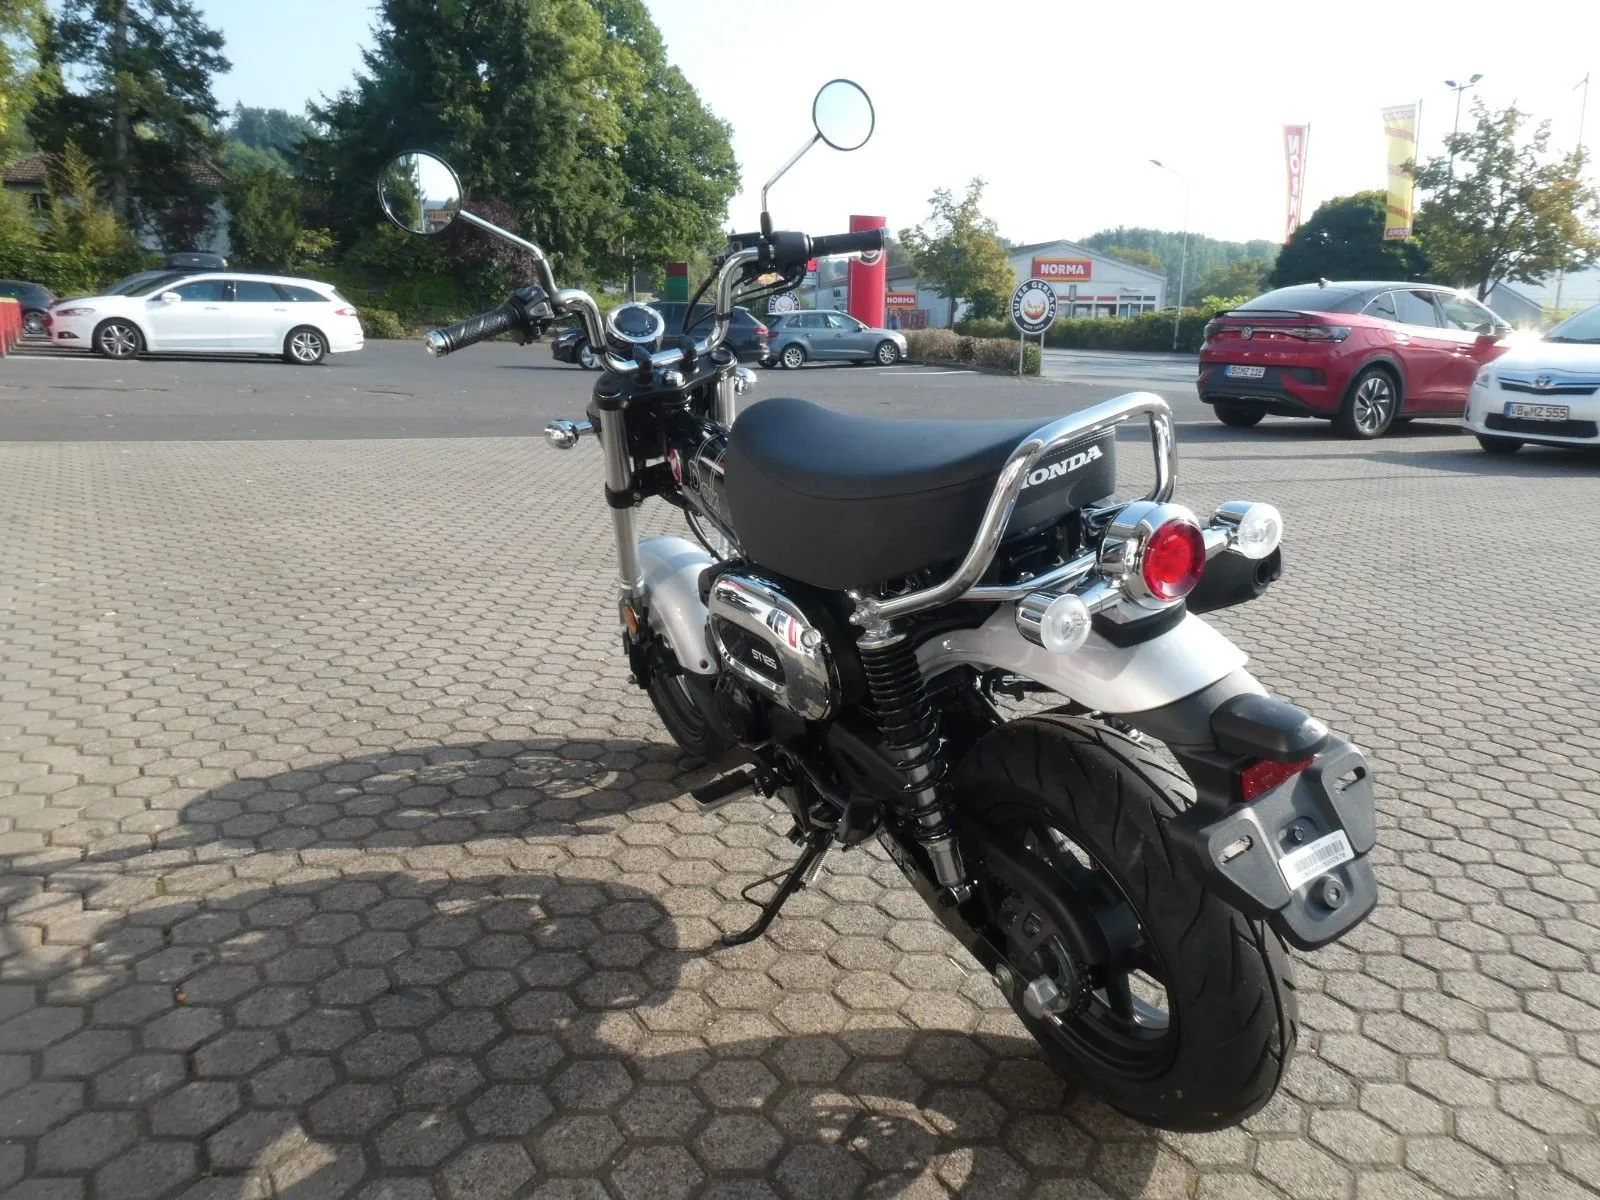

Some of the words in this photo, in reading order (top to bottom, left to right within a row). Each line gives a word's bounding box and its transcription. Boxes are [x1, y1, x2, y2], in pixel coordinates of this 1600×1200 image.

[1040, 263, 1085, 275] NORMA
[886, 296, 915, 305] NORMA
[1013, 285, 1029, 318] GUTER
[1031, 281, 1056, 318] GERLACH
[1545, 407, 1566, 419] 555
